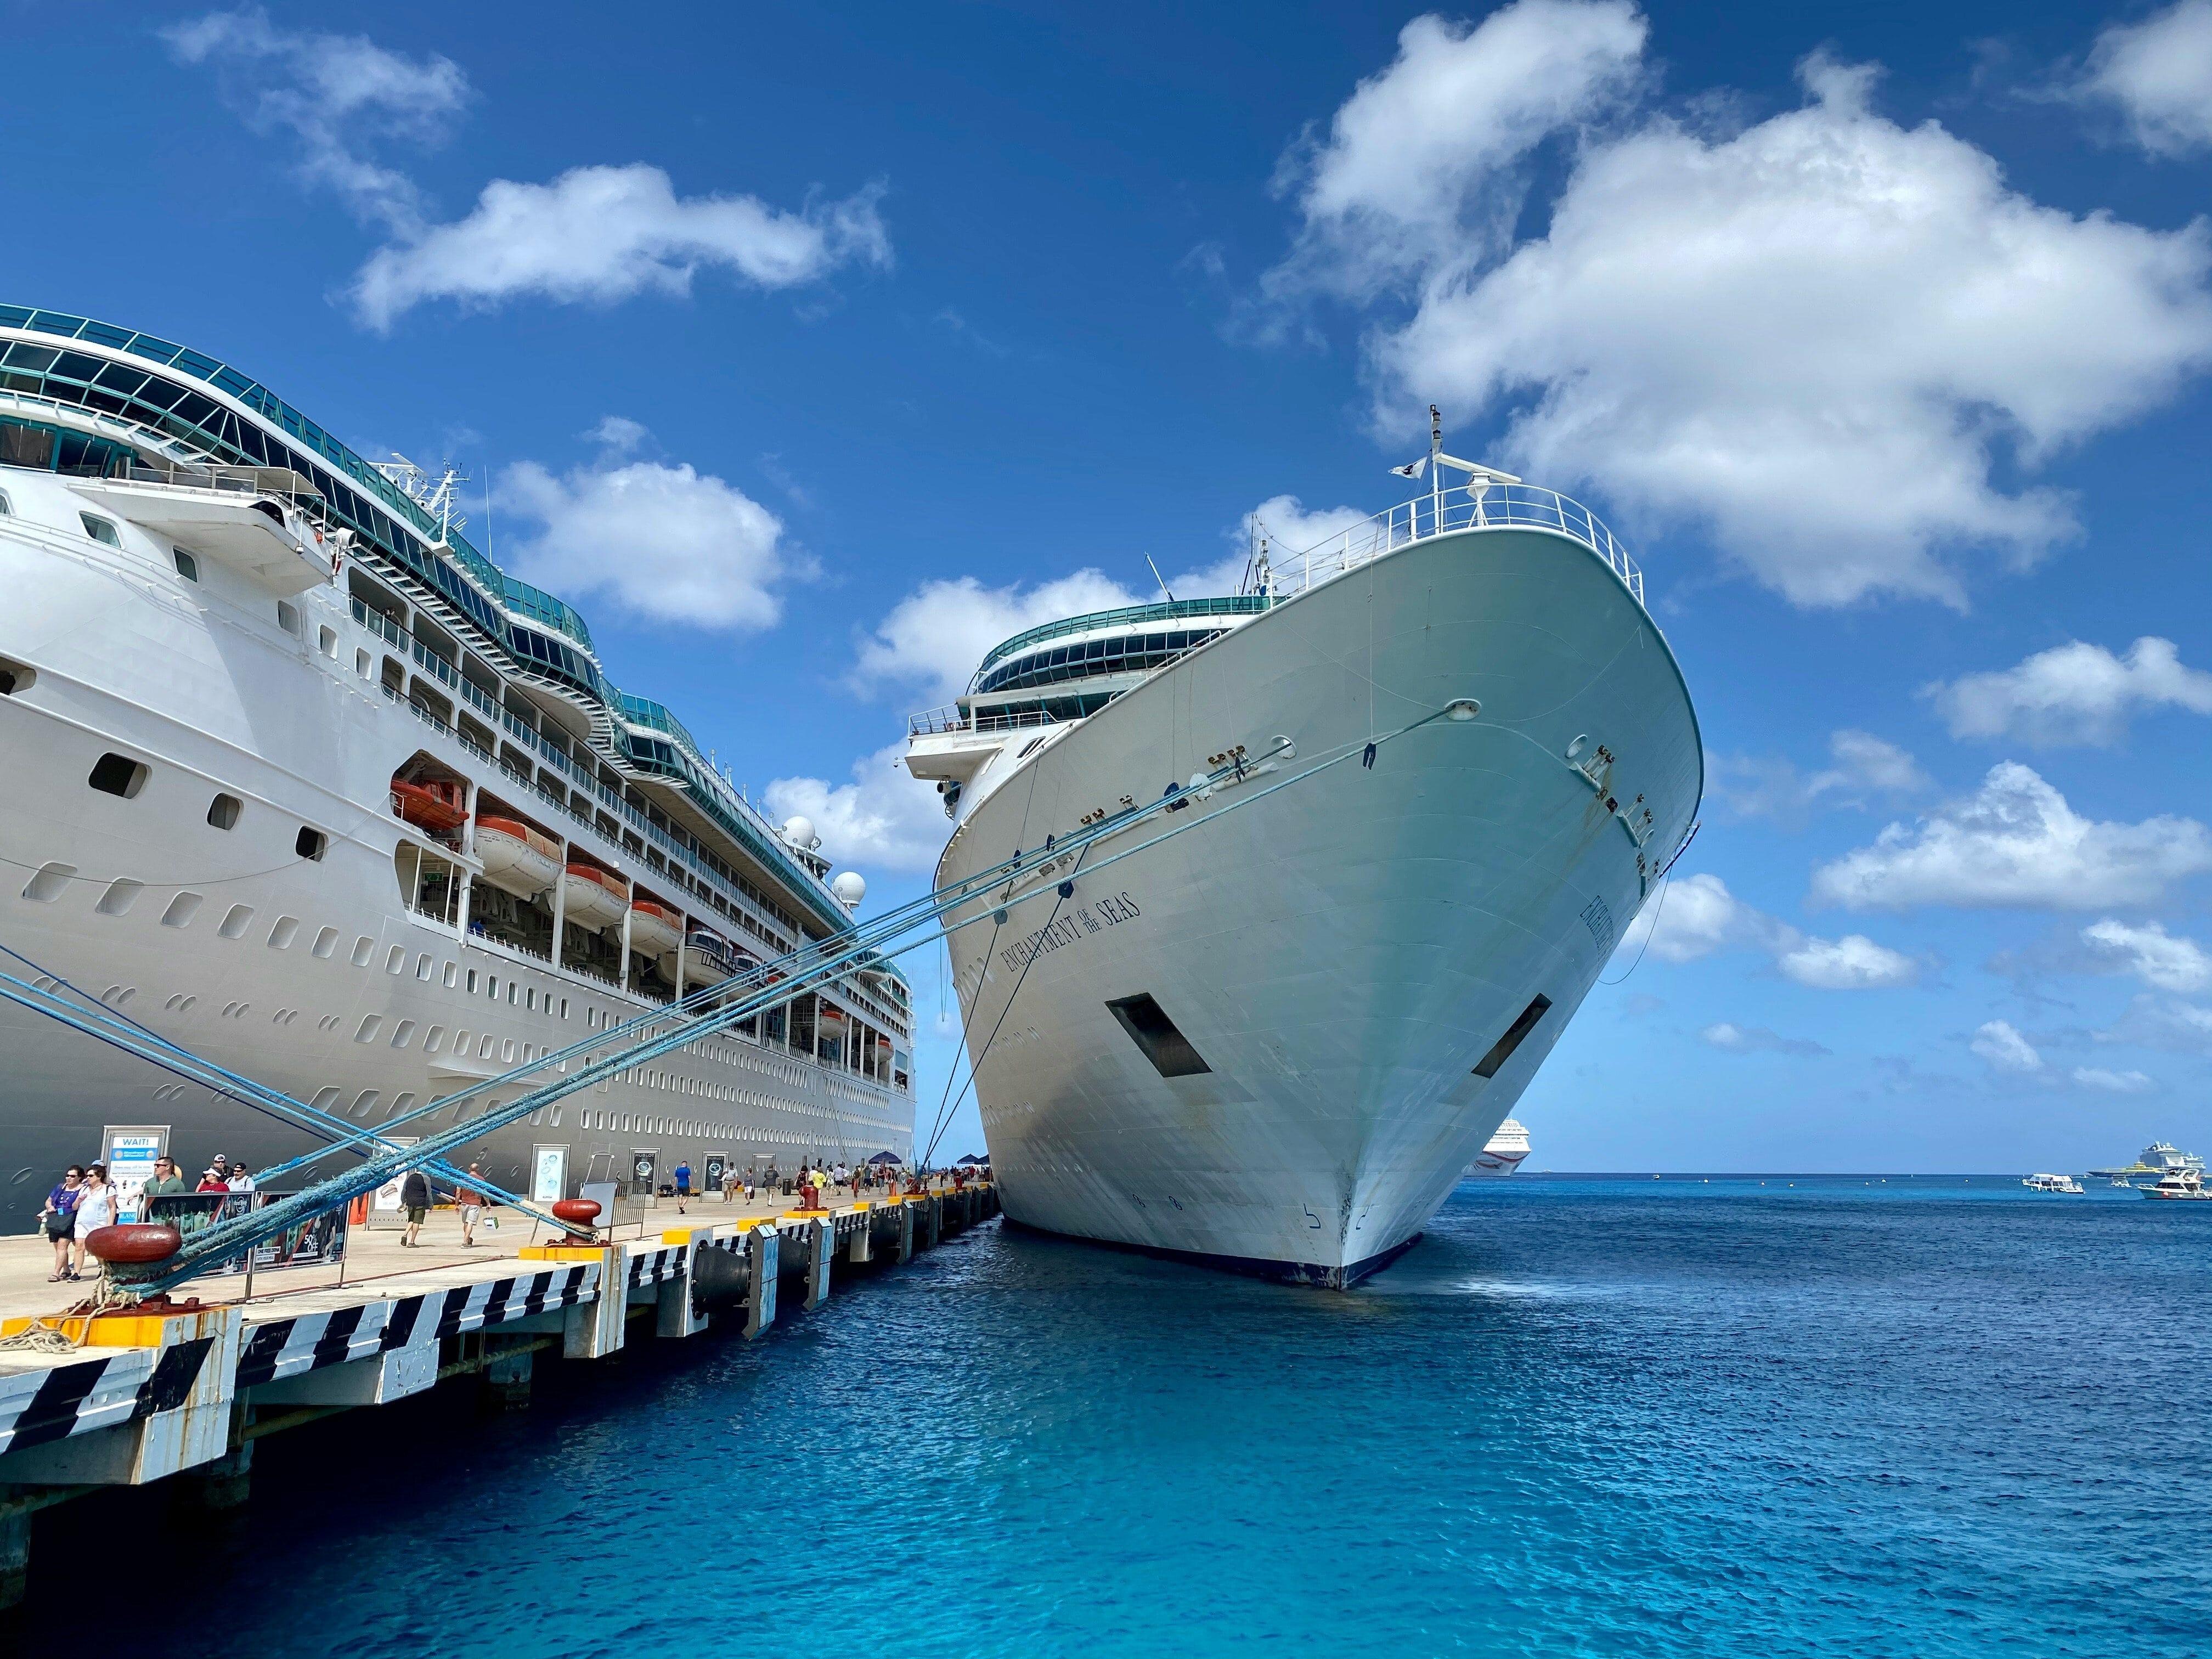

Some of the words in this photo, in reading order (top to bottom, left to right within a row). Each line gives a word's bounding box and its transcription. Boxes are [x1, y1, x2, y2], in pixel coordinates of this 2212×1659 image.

[1077, 909, 1090, 922] OF
[1096, 891, 1140, 926] SEAS
[1083, 918, 1102, 934] THE
[1000, 915, 1082, 972] ENCHANTMENT
